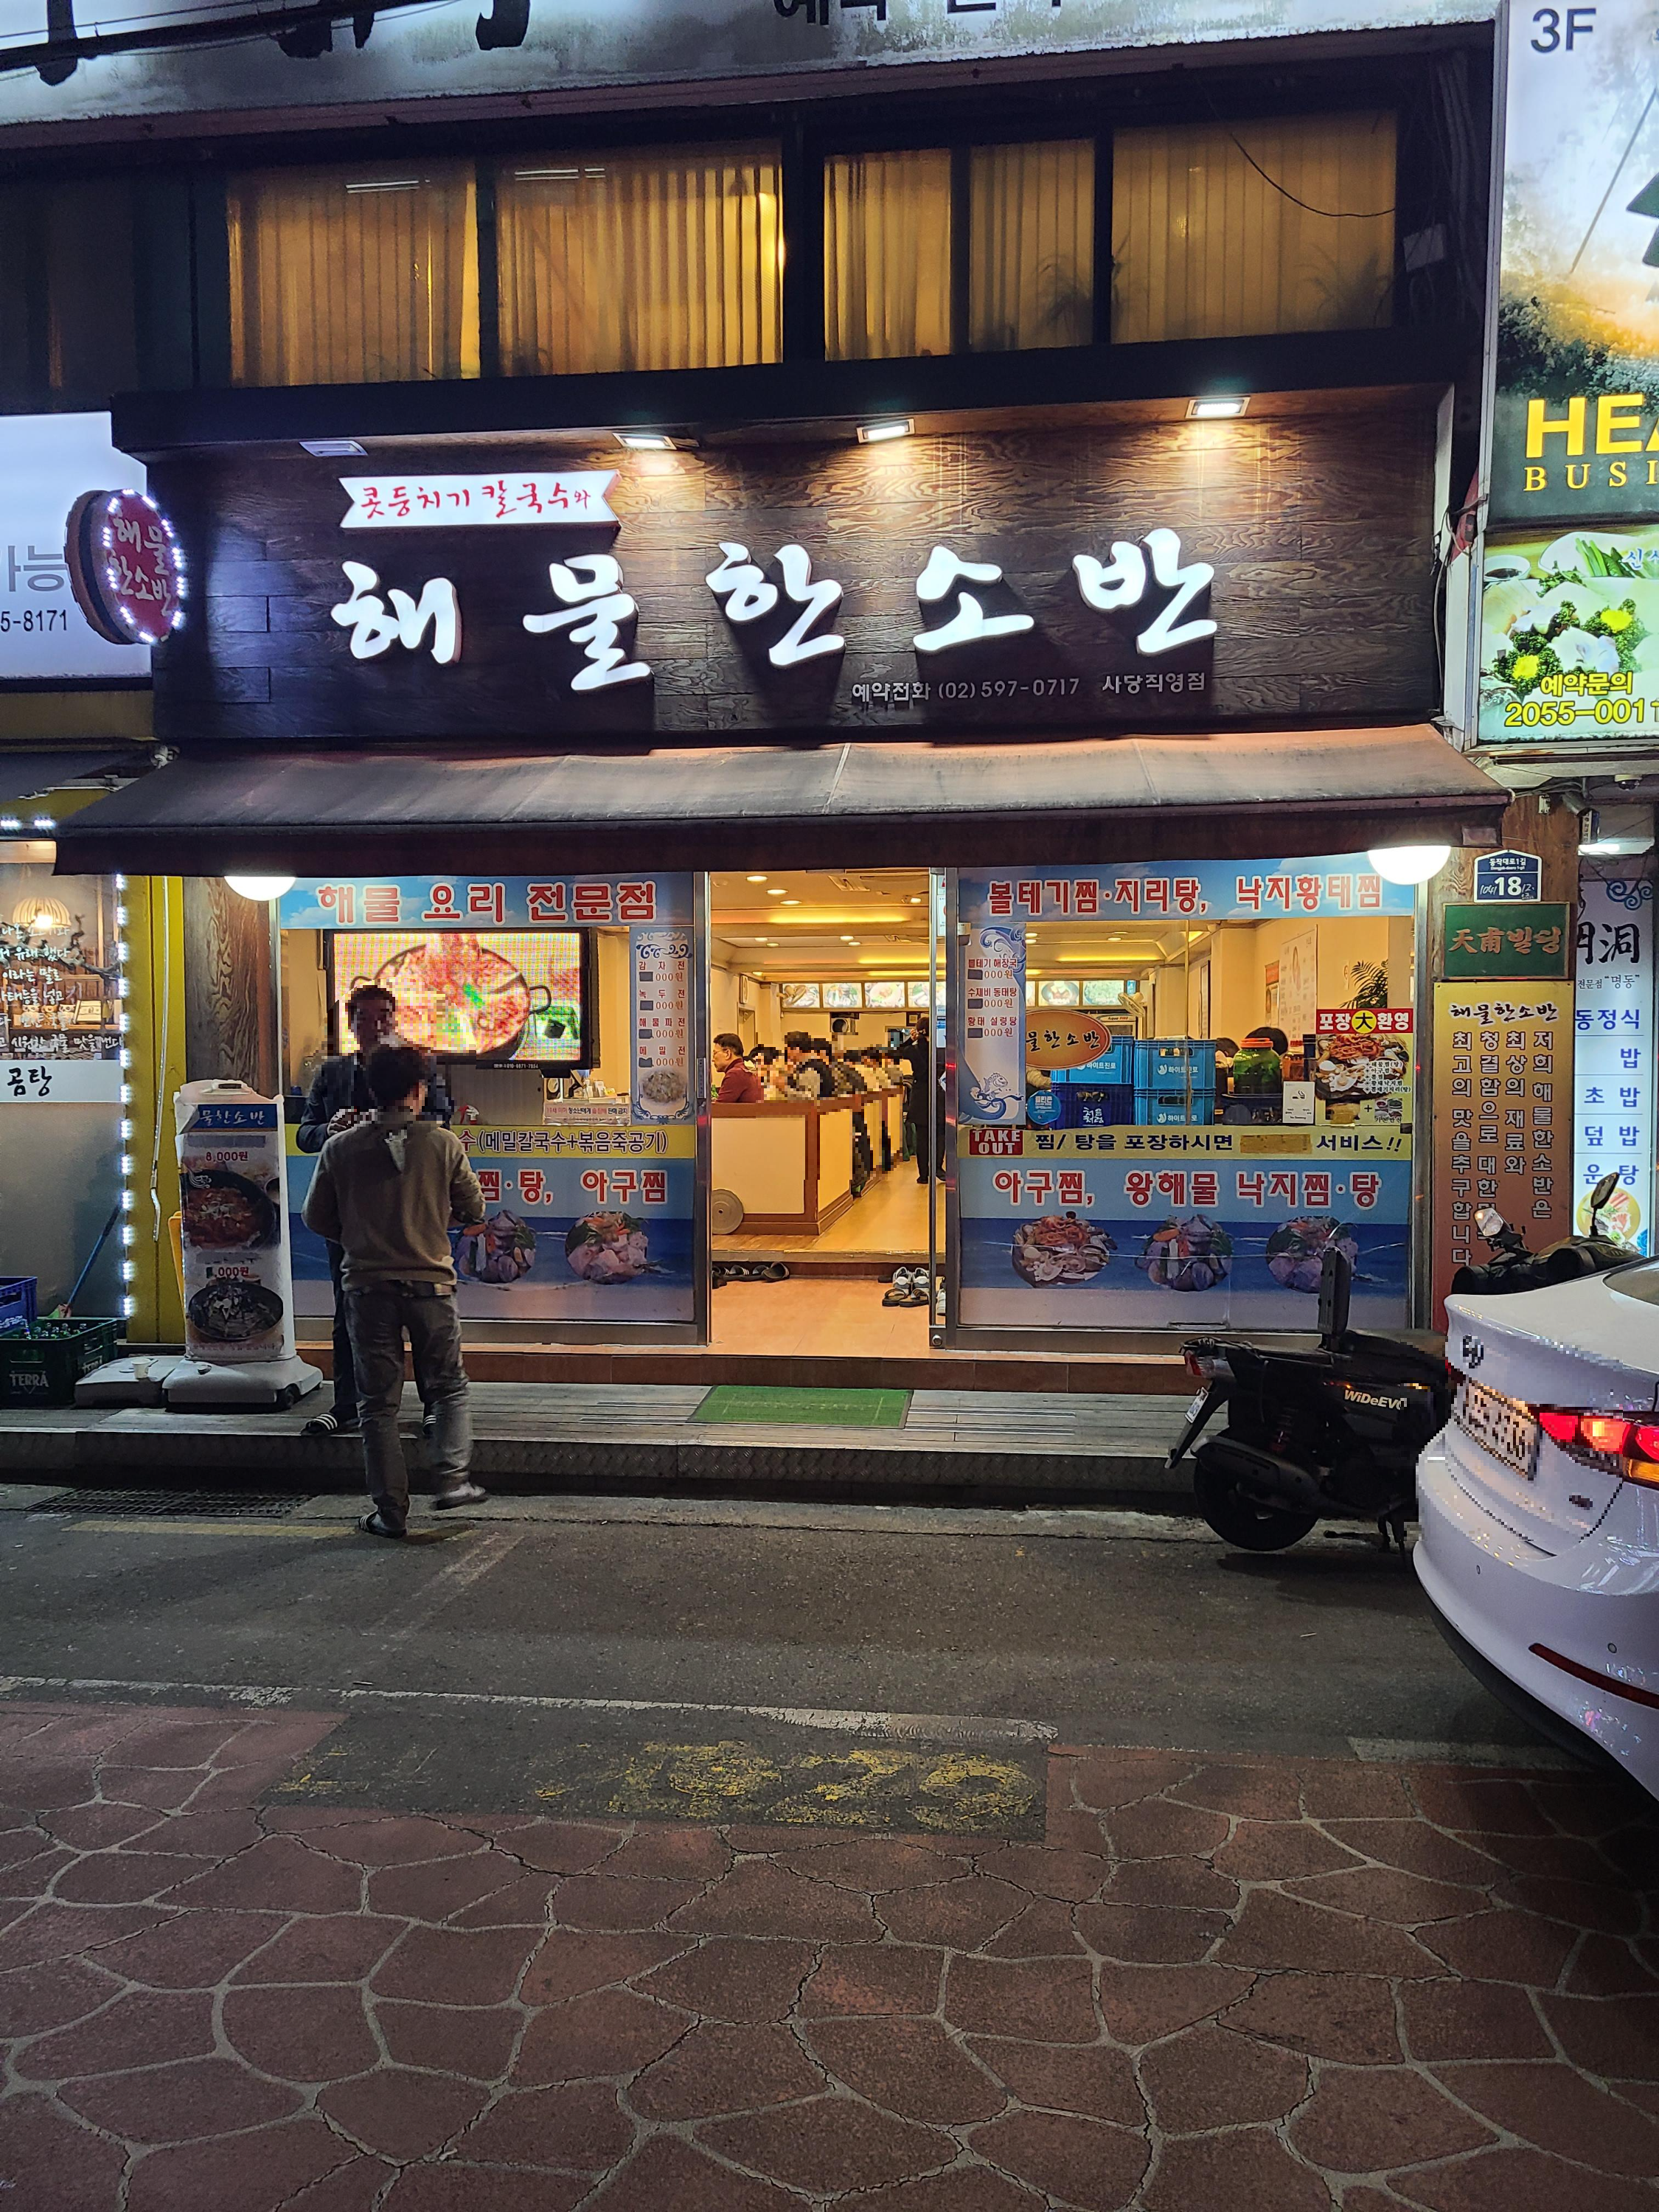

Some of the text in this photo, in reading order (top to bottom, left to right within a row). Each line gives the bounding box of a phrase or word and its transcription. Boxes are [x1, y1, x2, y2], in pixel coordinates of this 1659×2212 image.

[1531, 7, 1596, 53] 3F
[361, 479, 591, 520] 콧등치기 칼국수와
[331, 527, 1218, 693] 해물한소반
[852, 672, 1206, 703] 예약전화 (02) 597-0717 사당직영점
[1540, 672, 1633, 696] 예약문의
[1489, 858, 1526, 866] 동작대로1길
[1236, 874, 1381, 912] 낙지황태찜
[1494, 876, 1522, 896] 18
[318, 881, 656, 925] 해물 요리 전문점
[993, 987, 1018, 998] 동태탕
[1577, 978, 1602, 990] 전문점
[967, 1016, 1018, 1026] 황태 설렁탕
[1319, 1012, 1409, 1031] 포장 大 환영
[1450, 1003, 1558, 1026] 해물한소반
[1575, 1009, 1640, 1031] 동정식
[1452, 1032, 1472, 1097] 최고의
[1621, 1048, 1641, 1068] 밥
[7, 1065, 52, 1096] 곰탕
[1478, 1031, 1501, 1143] 청결함으로
[1505, 1031, 1528, 1175] 최상의 재료와
[973, 1130, 1020, 1142] TAKE
[1532, 1032, 1554, 1219] 저희 해물한소반은
[978, 1142, 1015, 1155] OUT
[1035, 1134, 1067, 1150] 찜/
[1075, 1134, 1116, 1151] 탕을
[1124, 1134, 1234, 1151] 포장하시면
[581, 1170, 666, 1203] 아구찜
[995, 1171, 1380, 1208] 아구찜, 왕해물 낙지찜·탕
[9, 1370, 49, 1388] TERRA
